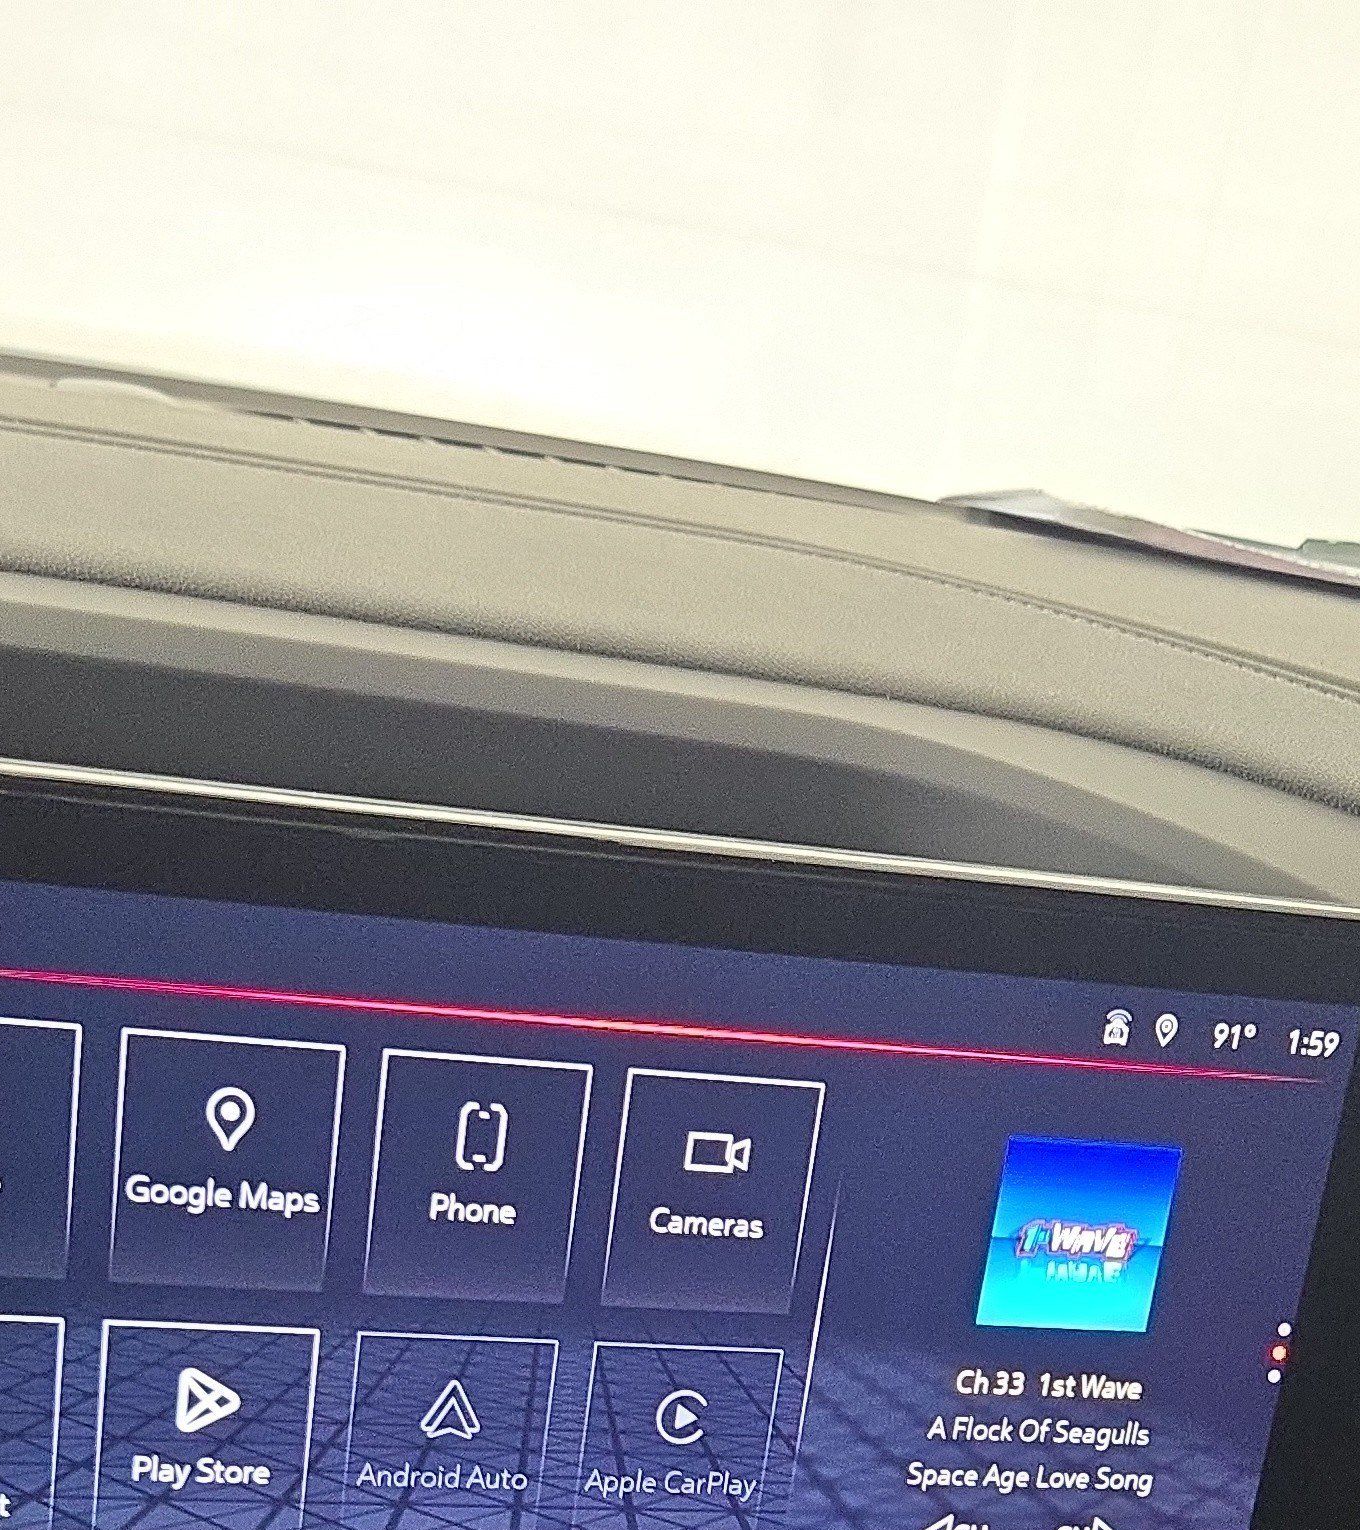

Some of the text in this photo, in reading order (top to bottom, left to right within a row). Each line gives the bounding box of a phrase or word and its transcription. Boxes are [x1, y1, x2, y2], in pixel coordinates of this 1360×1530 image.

[1289, 1029, 1340, 1058] 1:59
[124, 1174, 320, 1219] Google Maps
[429, 1192, 517, 1225] Phone
[649, 1206, 764, 1239] Cameras
[956, 1368, 1143, 1400] Ch 33 1st Wave
[926, 1415, 1150, 1452] A Flock Of Seagulls
[131, 1454, 271, 1490] Play Store
[355, 1462, 528, 1490] Android Auto
[583, 1468, 757, 1503] Apple CarPlay
[906, 1461, 1154, 1498] Space Age Love Song
